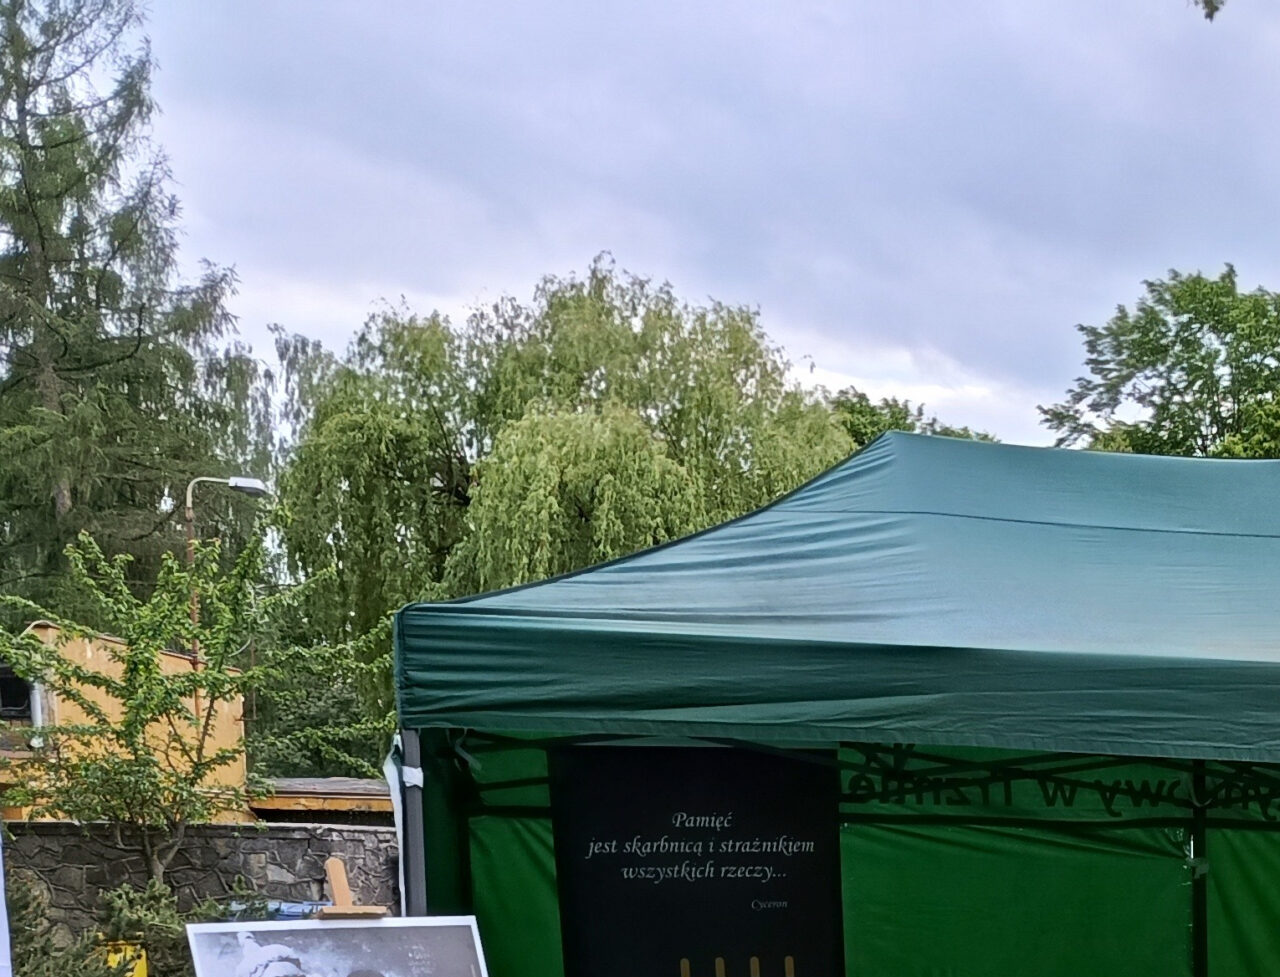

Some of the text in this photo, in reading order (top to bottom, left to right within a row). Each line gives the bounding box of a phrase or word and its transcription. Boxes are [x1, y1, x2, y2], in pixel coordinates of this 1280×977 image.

[671, 811, 733, 832] Pamięć
[586, 835, 815, 859] jest skarbnicą i strażnikiem
[621, 860, 788, 884] wszystkich rzeczy...
[751, 899, 788, 912] Cyceron
